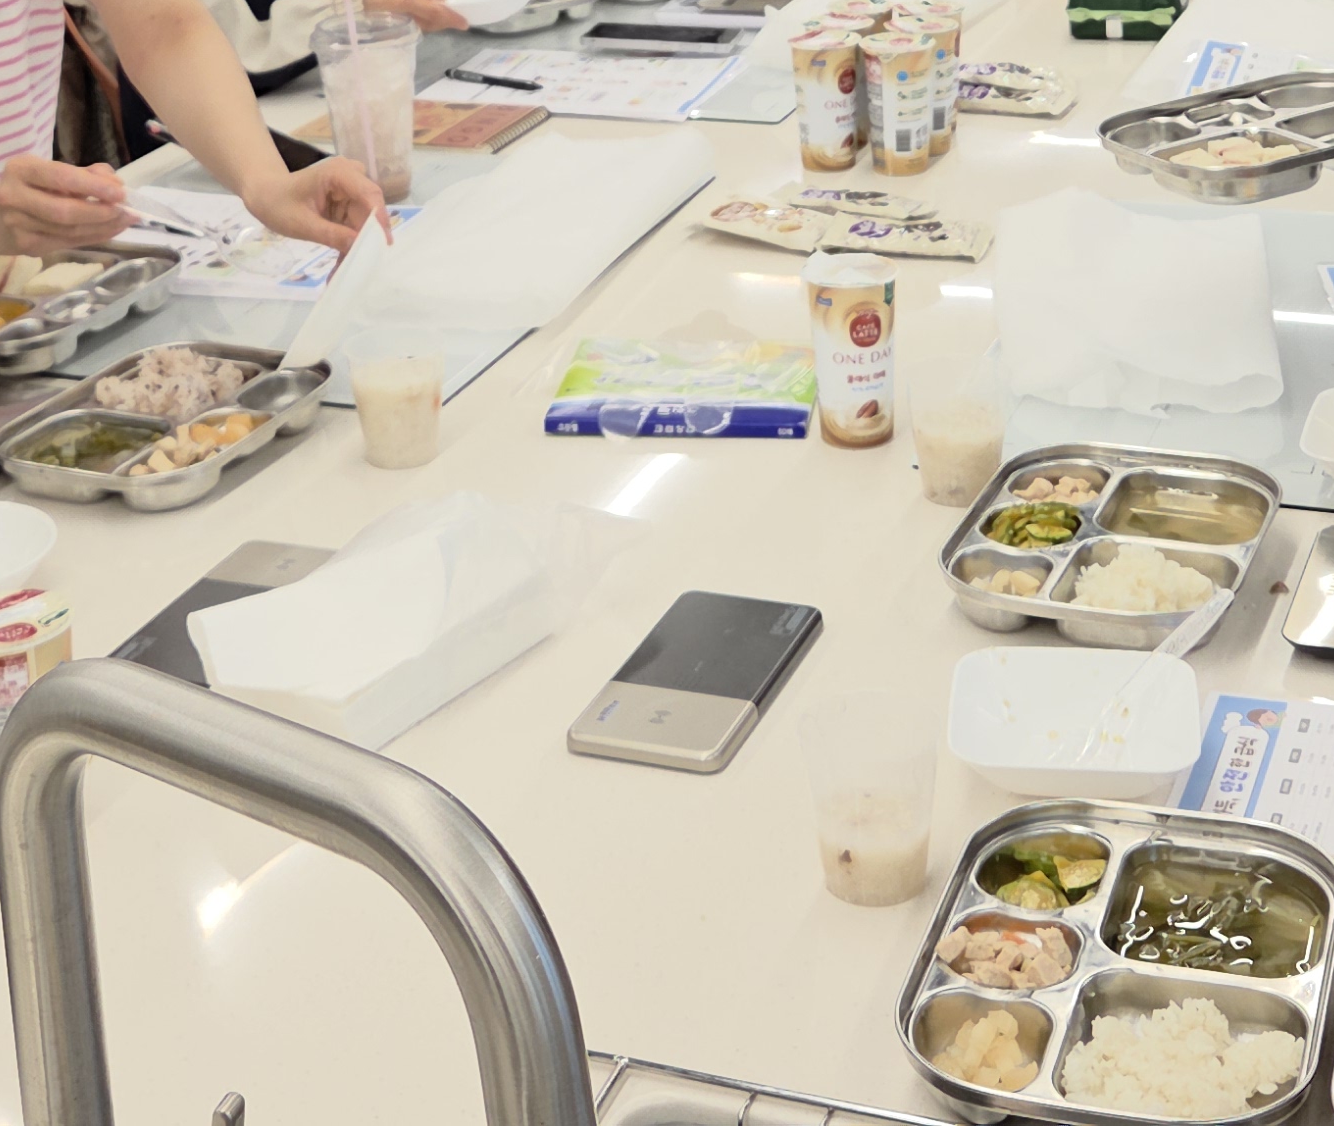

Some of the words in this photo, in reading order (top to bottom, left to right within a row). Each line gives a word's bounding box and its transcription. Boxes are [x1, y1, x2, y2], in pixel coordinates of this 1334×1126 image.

[832, 352, 866, 365] ONE
[1232, 735, 1259, 756] 급식
[1218, 757, 1251, 794] 안전한
